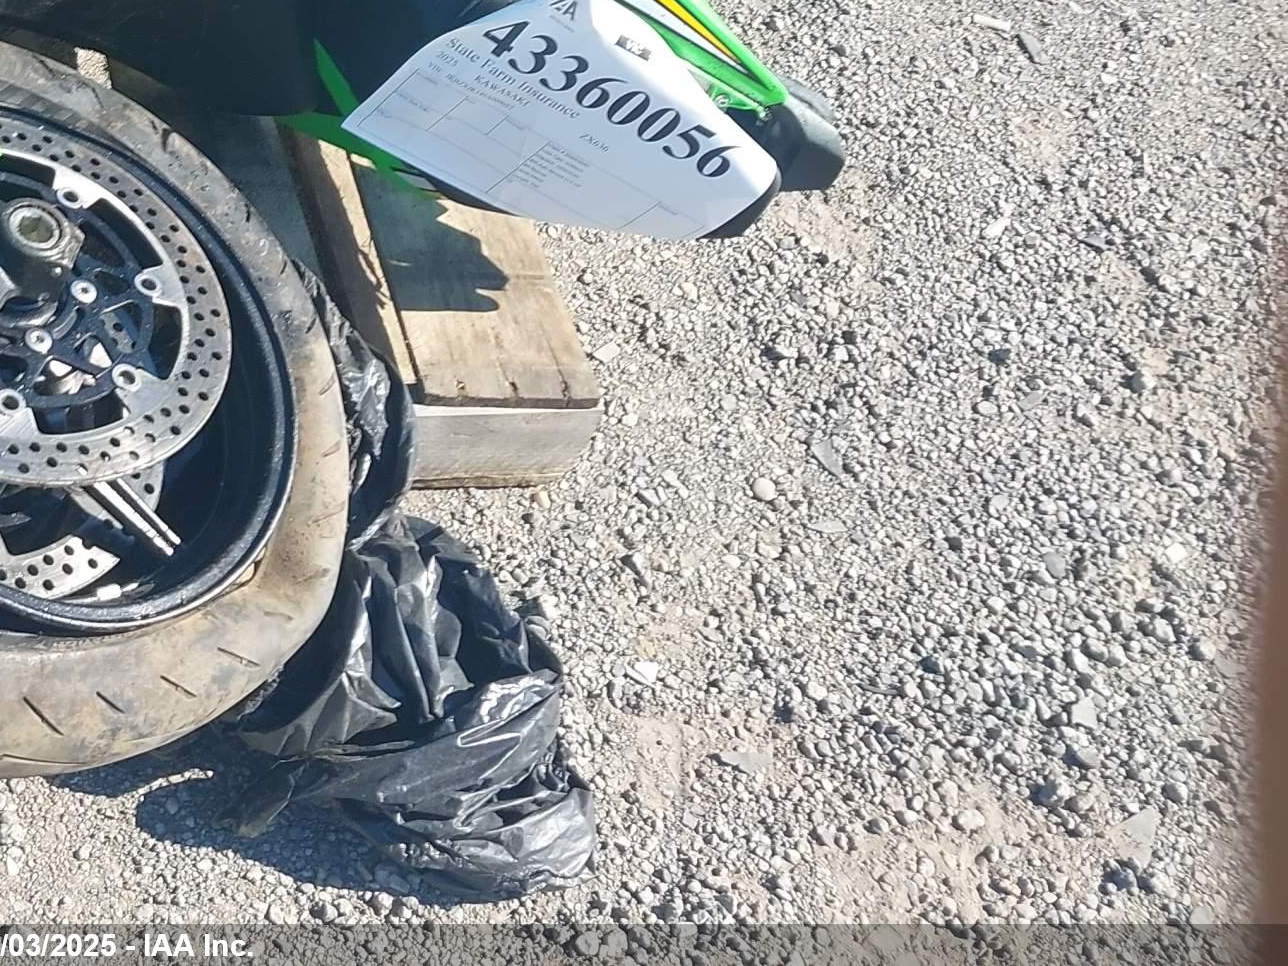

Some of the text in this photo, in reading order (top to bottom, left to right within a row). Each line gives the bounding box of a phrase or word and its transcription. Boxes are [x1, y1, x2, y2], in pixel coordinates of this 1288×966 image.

[435, 49, 459, 68] 2025
[474, 74, 531, 107] KAWASAKI
[445, 37, 481, 63] State
[480, 57, 518, 86] Farm
[517, 76, 581, 120] Insurance
[483, 20, 744, 179] 43360056
